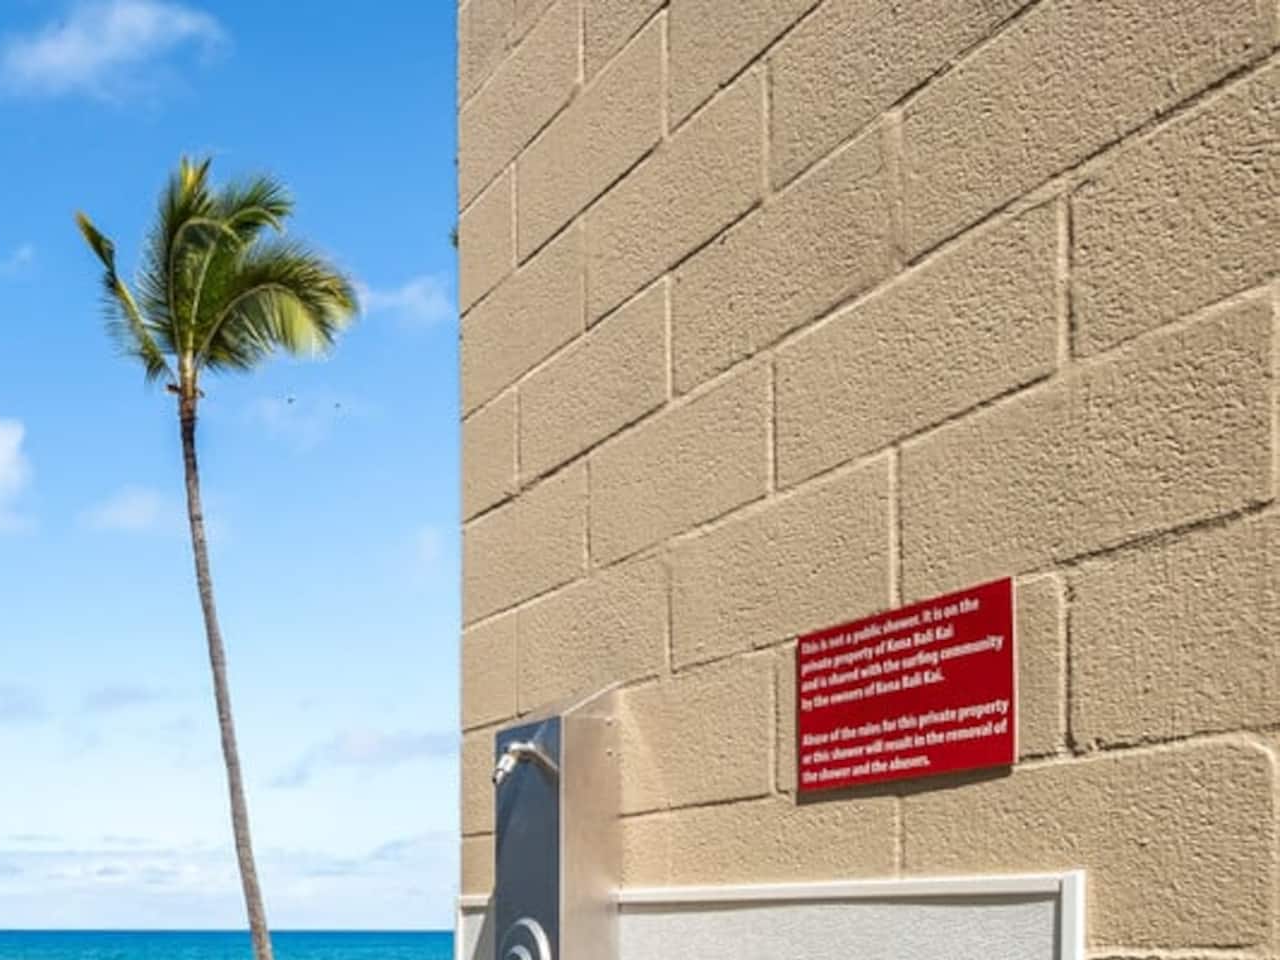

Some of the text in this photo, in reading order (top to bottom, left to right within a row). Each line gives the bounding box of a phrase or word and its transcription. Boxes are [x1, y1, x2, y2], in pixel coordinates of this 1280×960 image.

[802, 642, 819, 654] This
[829, 635, 843, 647] not
[853, 624, 881, 643] public
[960, 598, 978, 612] the
[802, 658, 830, 676] private
[832, 648, 872, 667] property
[886, 638, 911, 651] Kona
[936, 624, 953, 640] Kai
[802, 678, 816, 692] and
[828, 668, 858, 685] shared
[860, 663, 881, 678] with
[883, 660, 899, 672] the
[902, 652, 937, 668] surfing
[940, 636, 1003, 659] community
[813, 696, 828, 707] the
[876, 680, 899, 694] Kona
[924, 669, 944, 683] Kai.
[840, 727, 856, 739] the
[882, 720, 896, 731] for
[897, 716, 916, 729] this
[918, 709, 955, 728] private
[958, 700, 1007, 721] property
[813, 751, 829, 762] this
[831, 746, 862, 759] shower
[926, 731, 944, 744] the
[945, 722, 991, 741] removal
[802, 772, 816, 782] the
[818, 768, 850, 780] shower
[852, 762, 869, 775] and
[870, 760, 887, 772] the
